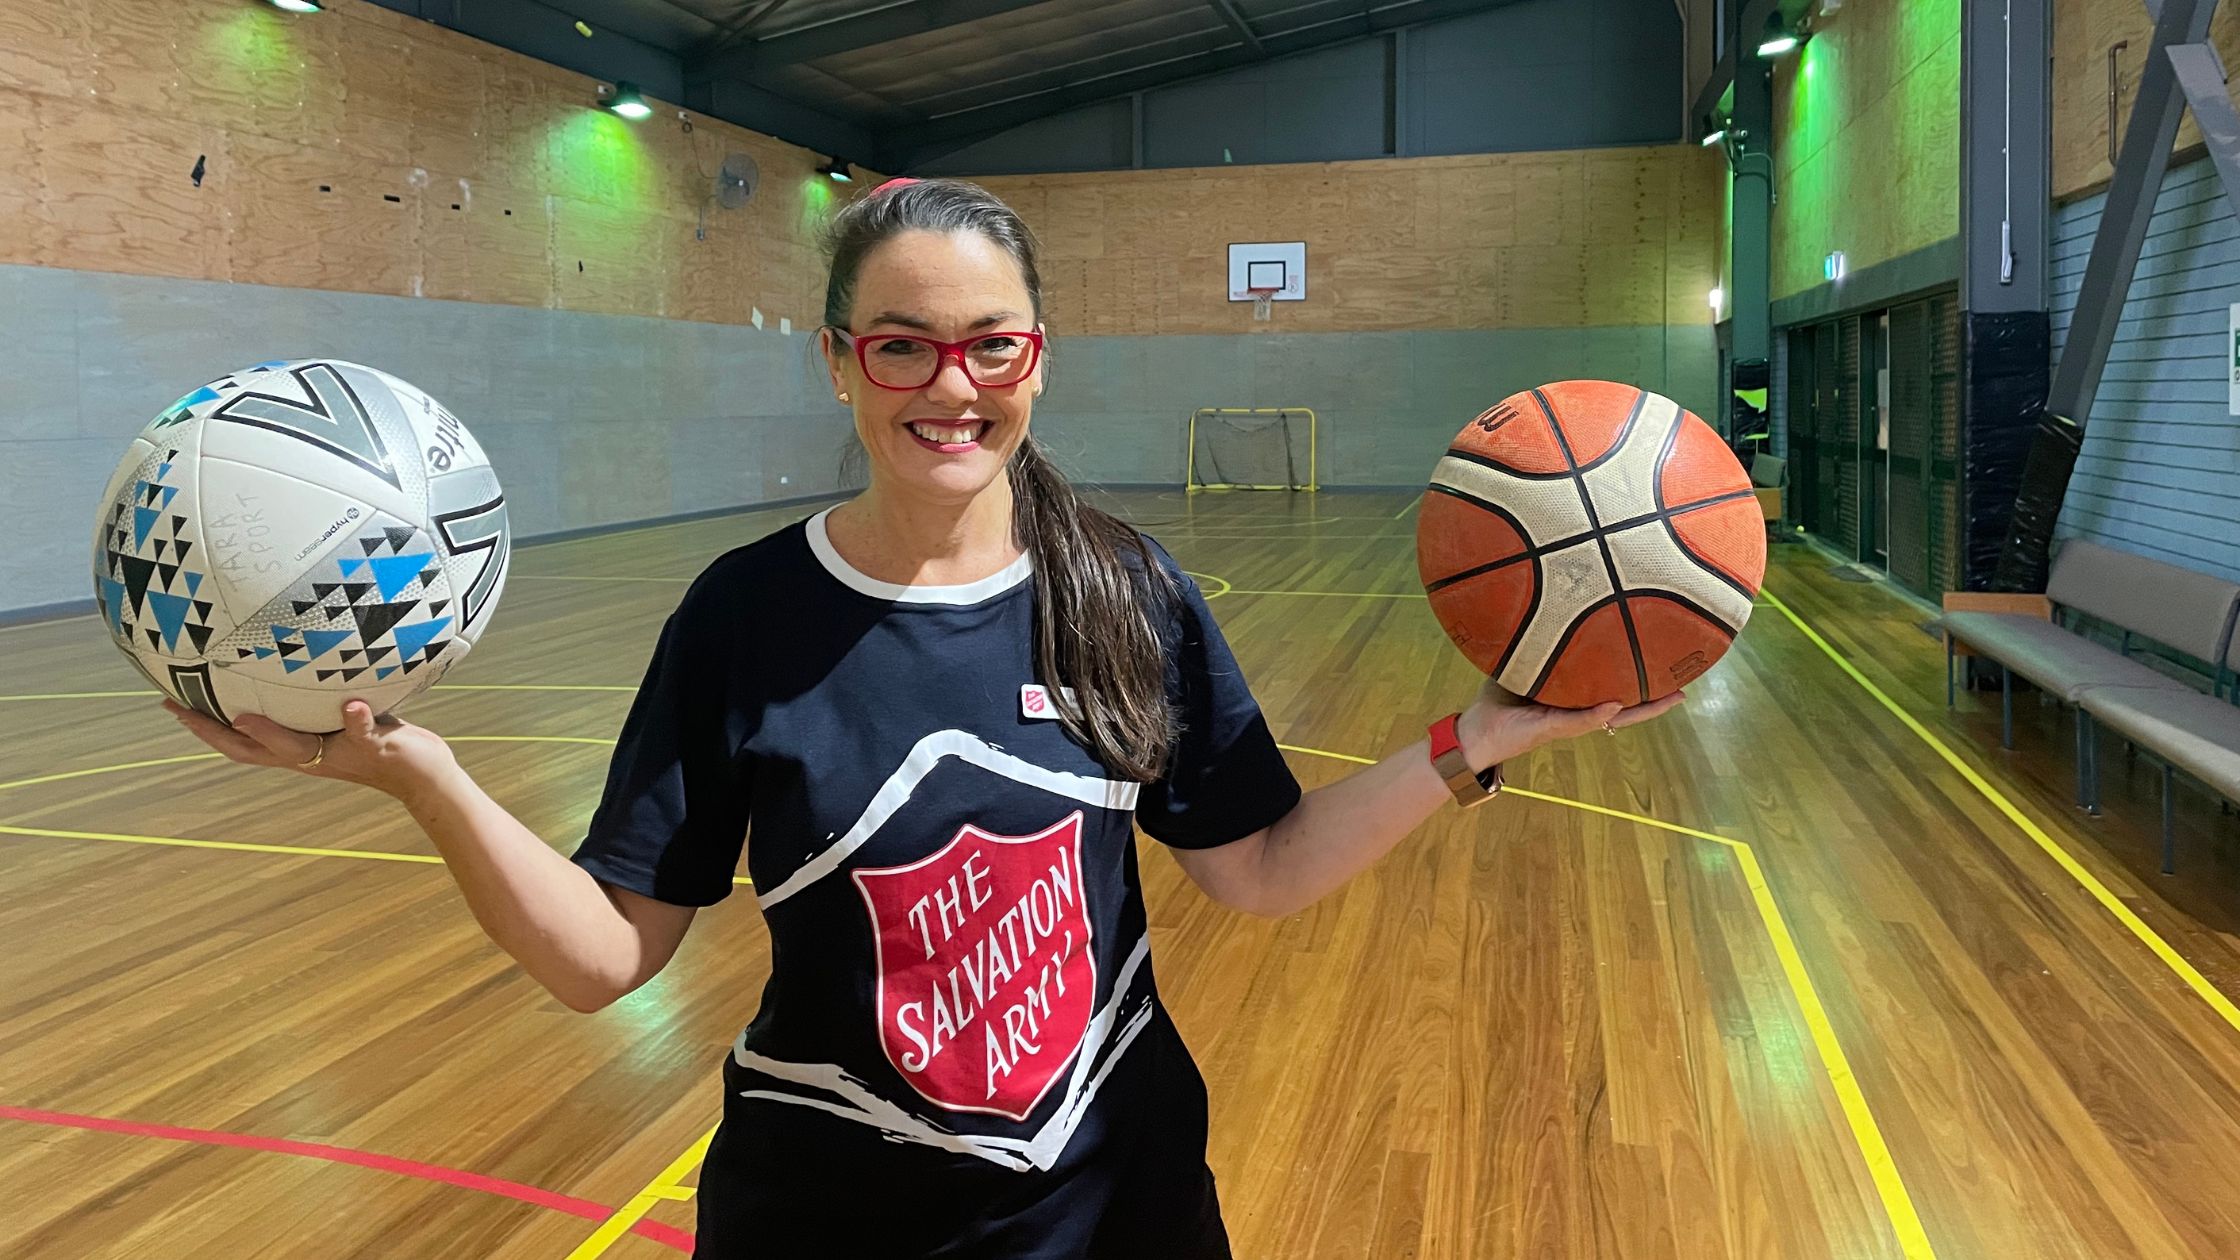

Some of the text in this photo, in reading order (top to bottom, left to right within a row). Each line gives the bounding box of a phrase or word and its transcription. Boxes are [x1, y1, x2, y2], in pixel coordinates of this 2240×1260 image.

[209, 513, 252, 592] TARA
[236, 493, 282, 573] SPORT
[294, 516, 350, 561] hyperseam
[908, 850, 992, 960] THE
[896, 846, 1073, 1073] SALVATION
[985, 930, 1071, 1101] ARMY
